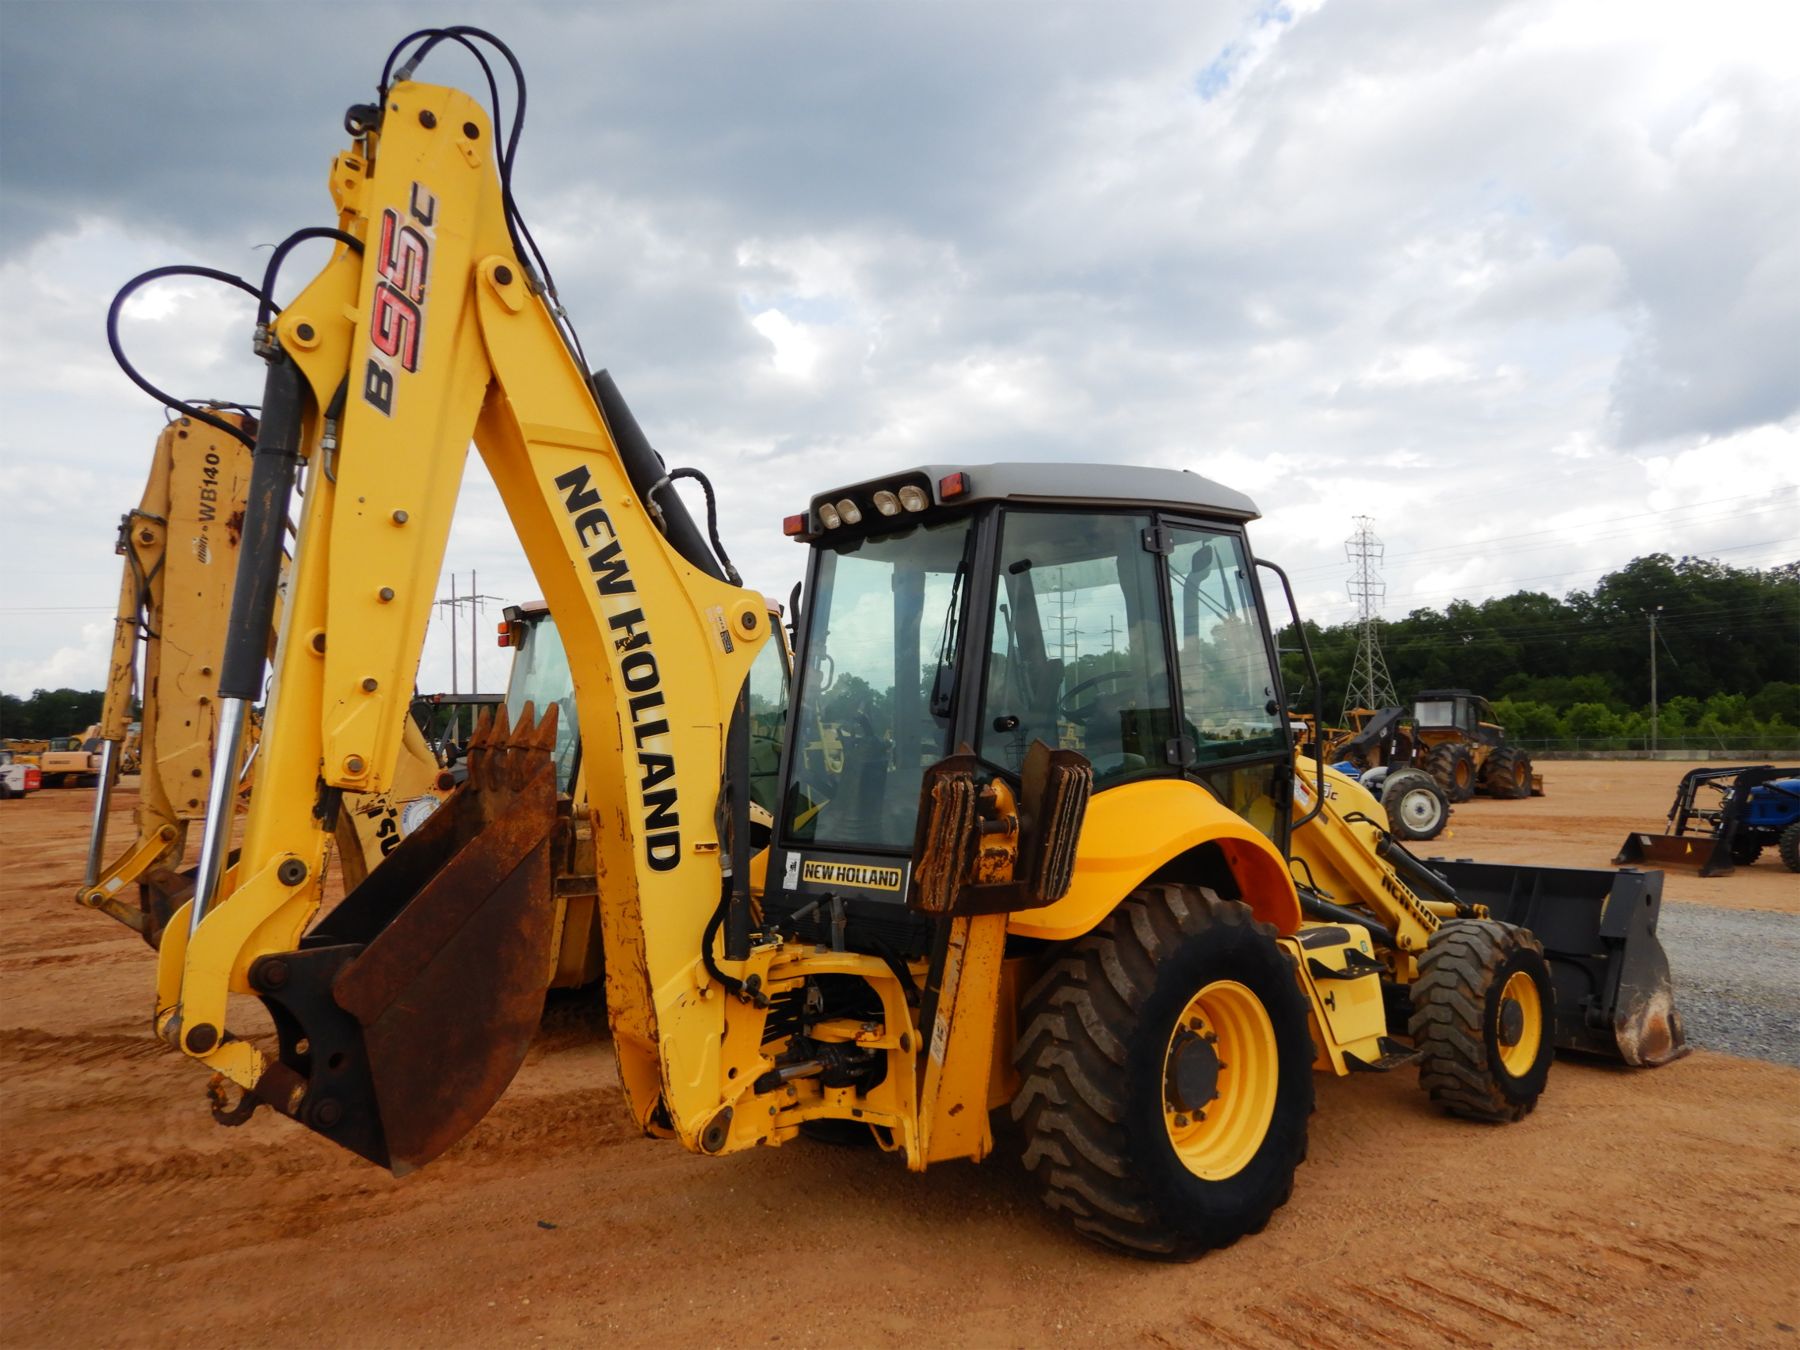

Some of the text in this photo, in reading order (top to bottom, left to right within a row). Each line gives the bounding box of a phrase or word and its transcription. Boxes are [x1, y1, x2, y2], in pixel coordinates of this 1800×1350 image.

[198, 453, 220, 522] WB140
[554, 464, 681, 872] NEW HOLLAND
[804, 863, 834, 880] NEW
[836, 866, 899, 887] HOLLAND
